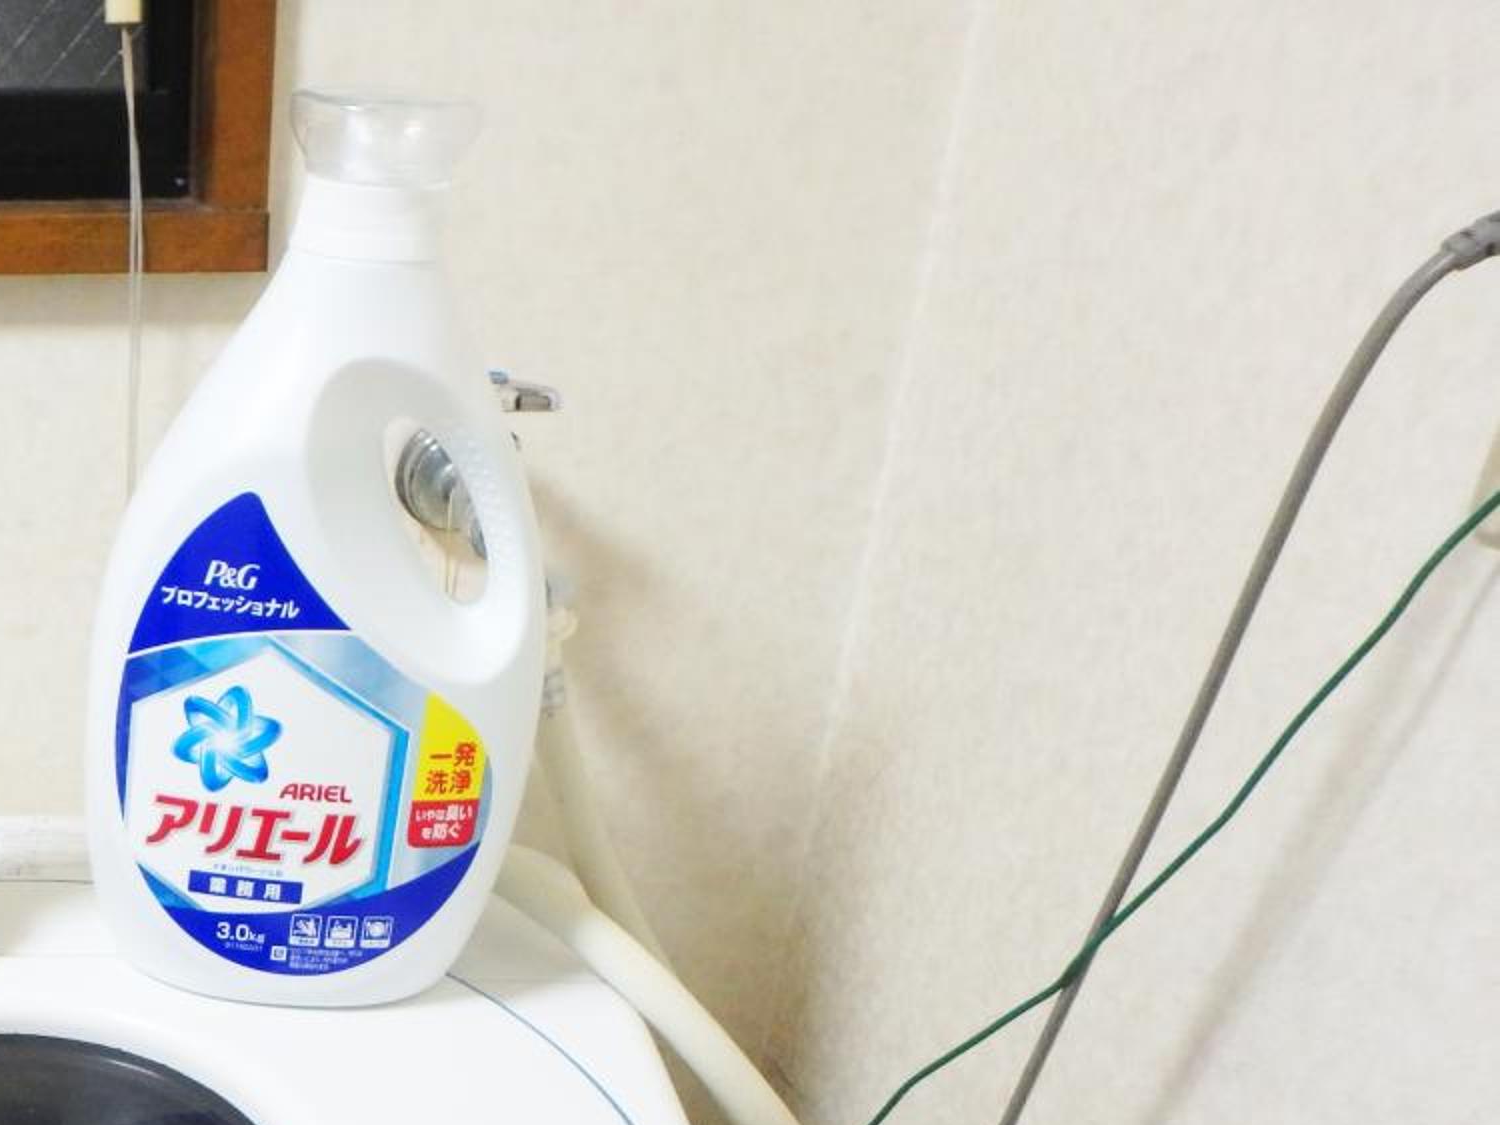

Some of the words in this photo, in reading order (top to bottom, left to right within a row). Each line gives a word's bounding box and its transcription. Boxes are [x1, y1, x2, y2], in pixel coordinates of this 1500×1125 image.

[204, 559, 260, 590] P&G
[161, 585, 300, 619] プロフェッショナル
[429, 741, 477, 767] 一発
[279, 783, 353, 803] ARIEL
[424, 769, 472, 795] 洗浄
[146, 794, 362, 864] アリエール
[208, 876, 282, 900] 業務用
[214, 921, 265, 944] 3.0kg
